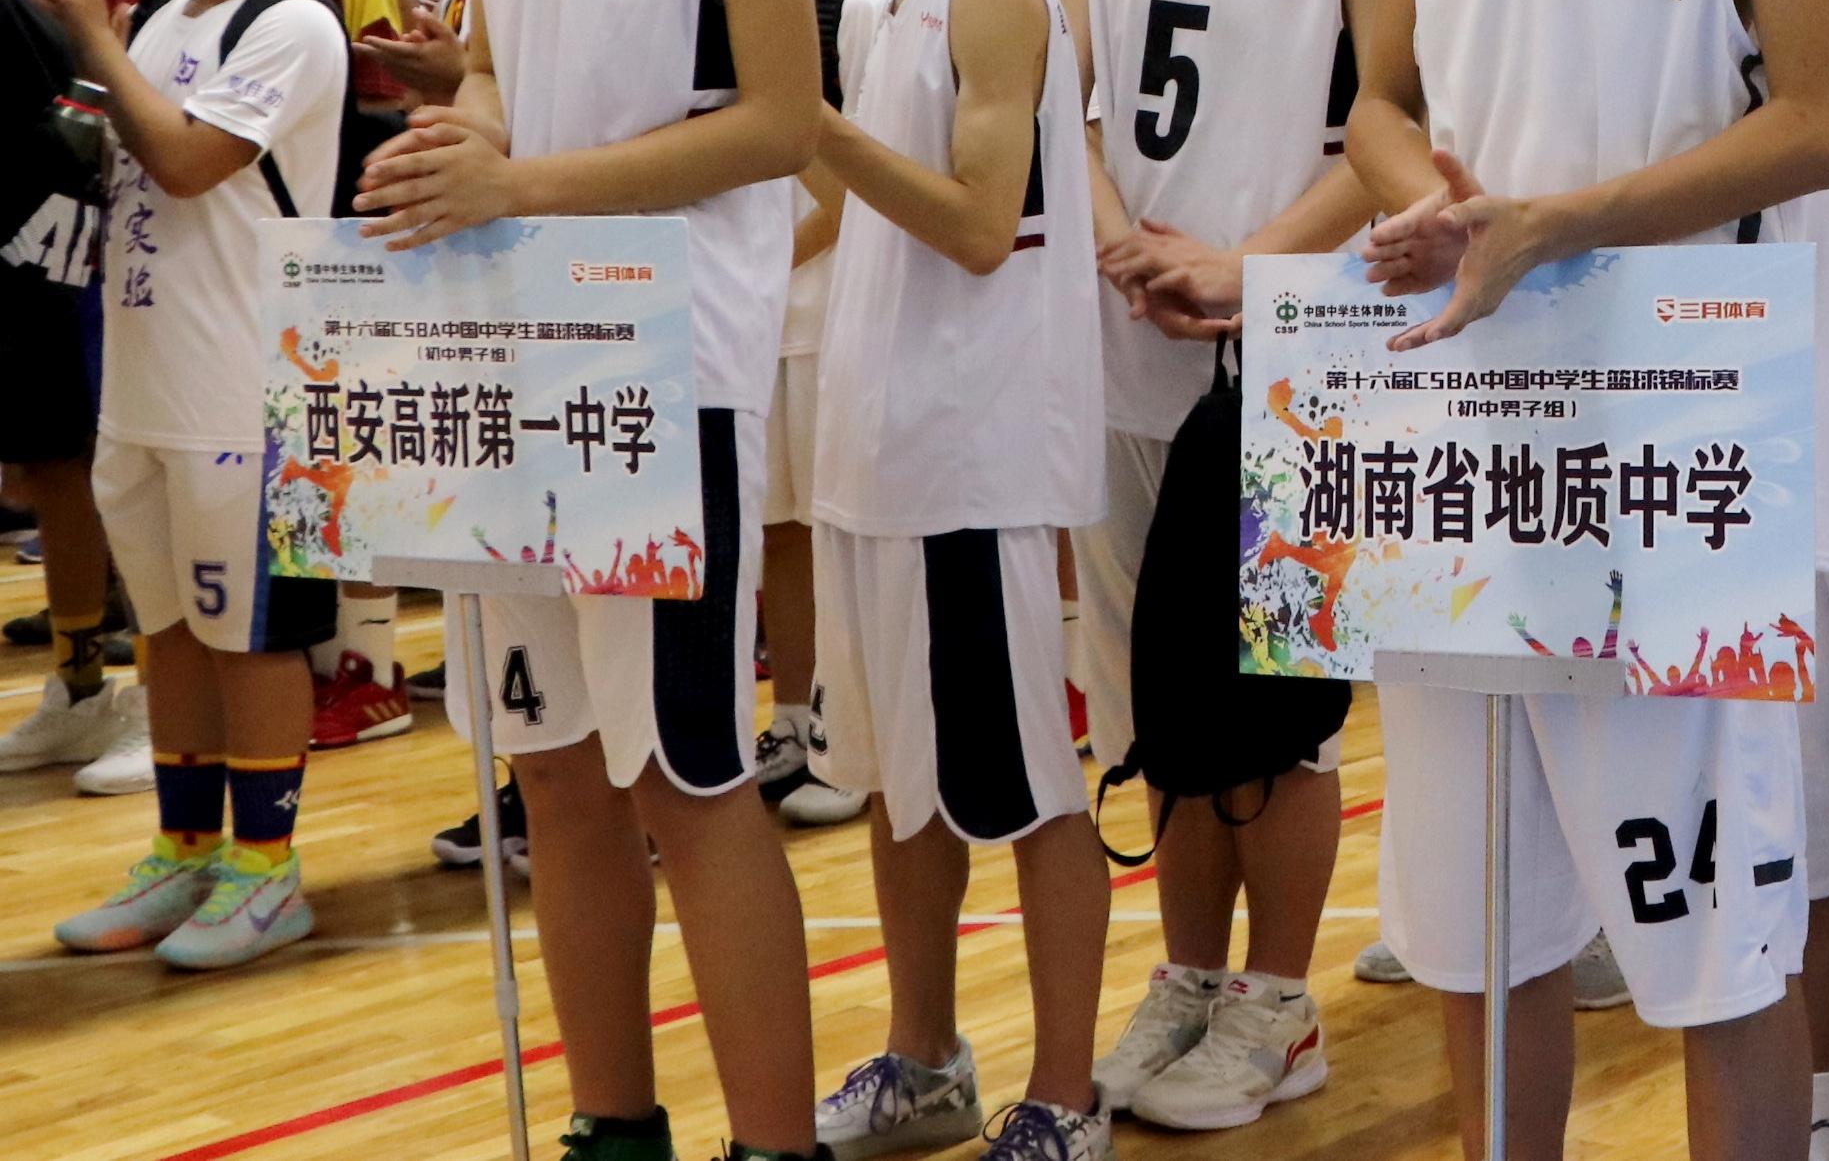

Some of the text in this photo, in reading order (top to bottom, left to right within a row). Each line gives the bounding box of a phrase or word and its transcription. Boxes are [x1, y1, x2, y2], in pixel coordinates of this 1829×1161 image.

[121, 177, 158, 308] 实验
[588, 266, 653, 282] 三月体育
[1303, 303, 1408, 318] 中国中学生体育协会
[1678, 300, 1766, 321] 三月体育
[324, 320, 635, 342] 第十六届CSBA中国中学生篮球锦标赛
[1274, 326, 1299, 334] CSSF
[1324, 320, 1346, 328] School
[1348, 321, 1369, 329] Sports
[1372, 320, 1408, 328] Federation
[1325, 368, 1740, 393] 第十六届CSBA中国中学生篮球锦标赛
[302, 380, 657, 474] 西安高新第一中学
[1299, 441, 1753, 551] 湖南省地质中学
[191, 561, 227, 620] 5
[499, 645, 546, 726] 4
[1615, 798, 1718, 924] 24
